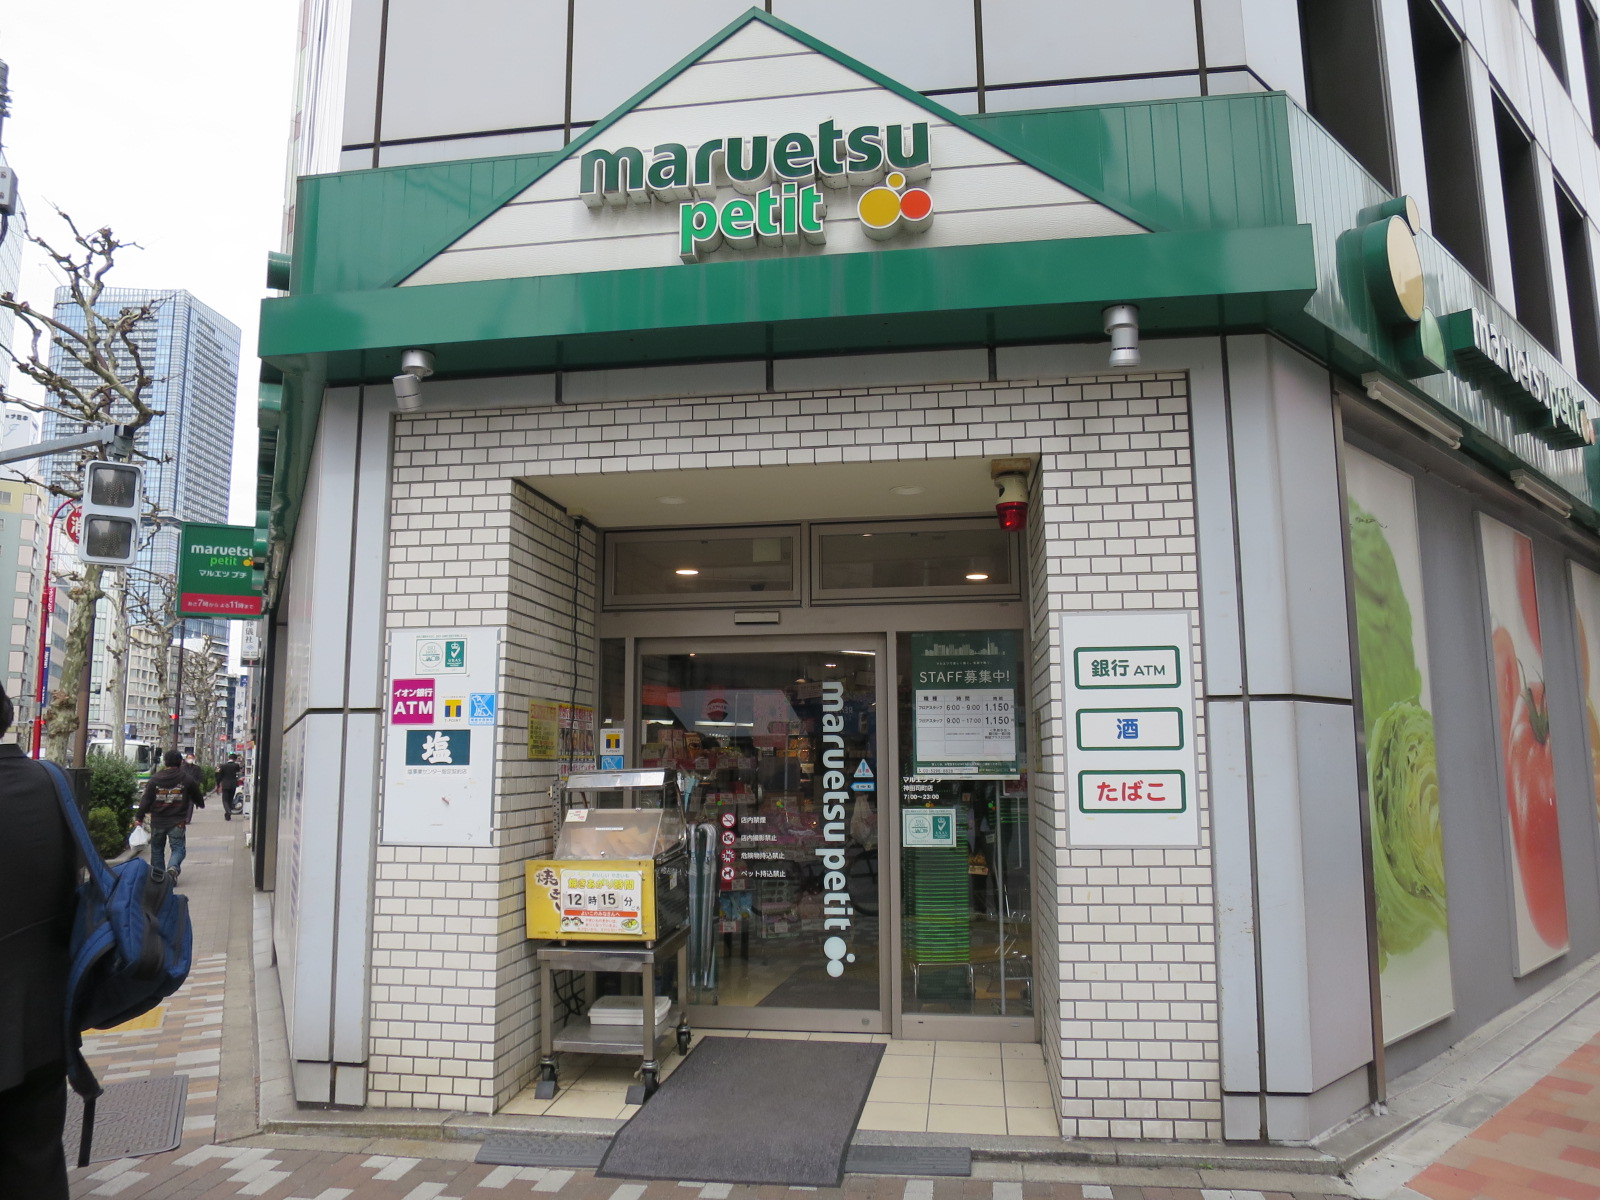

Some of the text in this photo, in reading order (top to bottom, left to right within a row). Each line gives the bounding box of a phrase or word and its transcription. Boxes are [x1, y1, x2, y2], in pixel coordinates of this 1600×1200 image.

[579, 117, 931, 195] maruetsu
[680, 182, 825, 256] petit
[1471, 307, 1551, 409] maruetsu
[210, 556, 237, 567] petit
[199, 569, 247, 579] マルエツ プチ
[1091, 659, 1166, 677] 銀行 ATM
[394, 687, 433, 698] イオン銀行
[394, 701, 433, 715] ATM
[1116, 718, 1139, 740] 酒
[421, 731, 453, 764] 塩
[822, 681, 849, 842] maruetsu
[1096, 780, 1166, 802] たばこ
[740, 816, 767, 824] 店内禁煙
[740, 834, 778, 842] 店内撮影禁止
[740, 852, 785, 860] 危険物持込禁止
[567, 878, 635, 890] 焼きあがり時間
[815, 848, 854, 931] petit
[567, 892, 633, 907] 12 時 15 分
